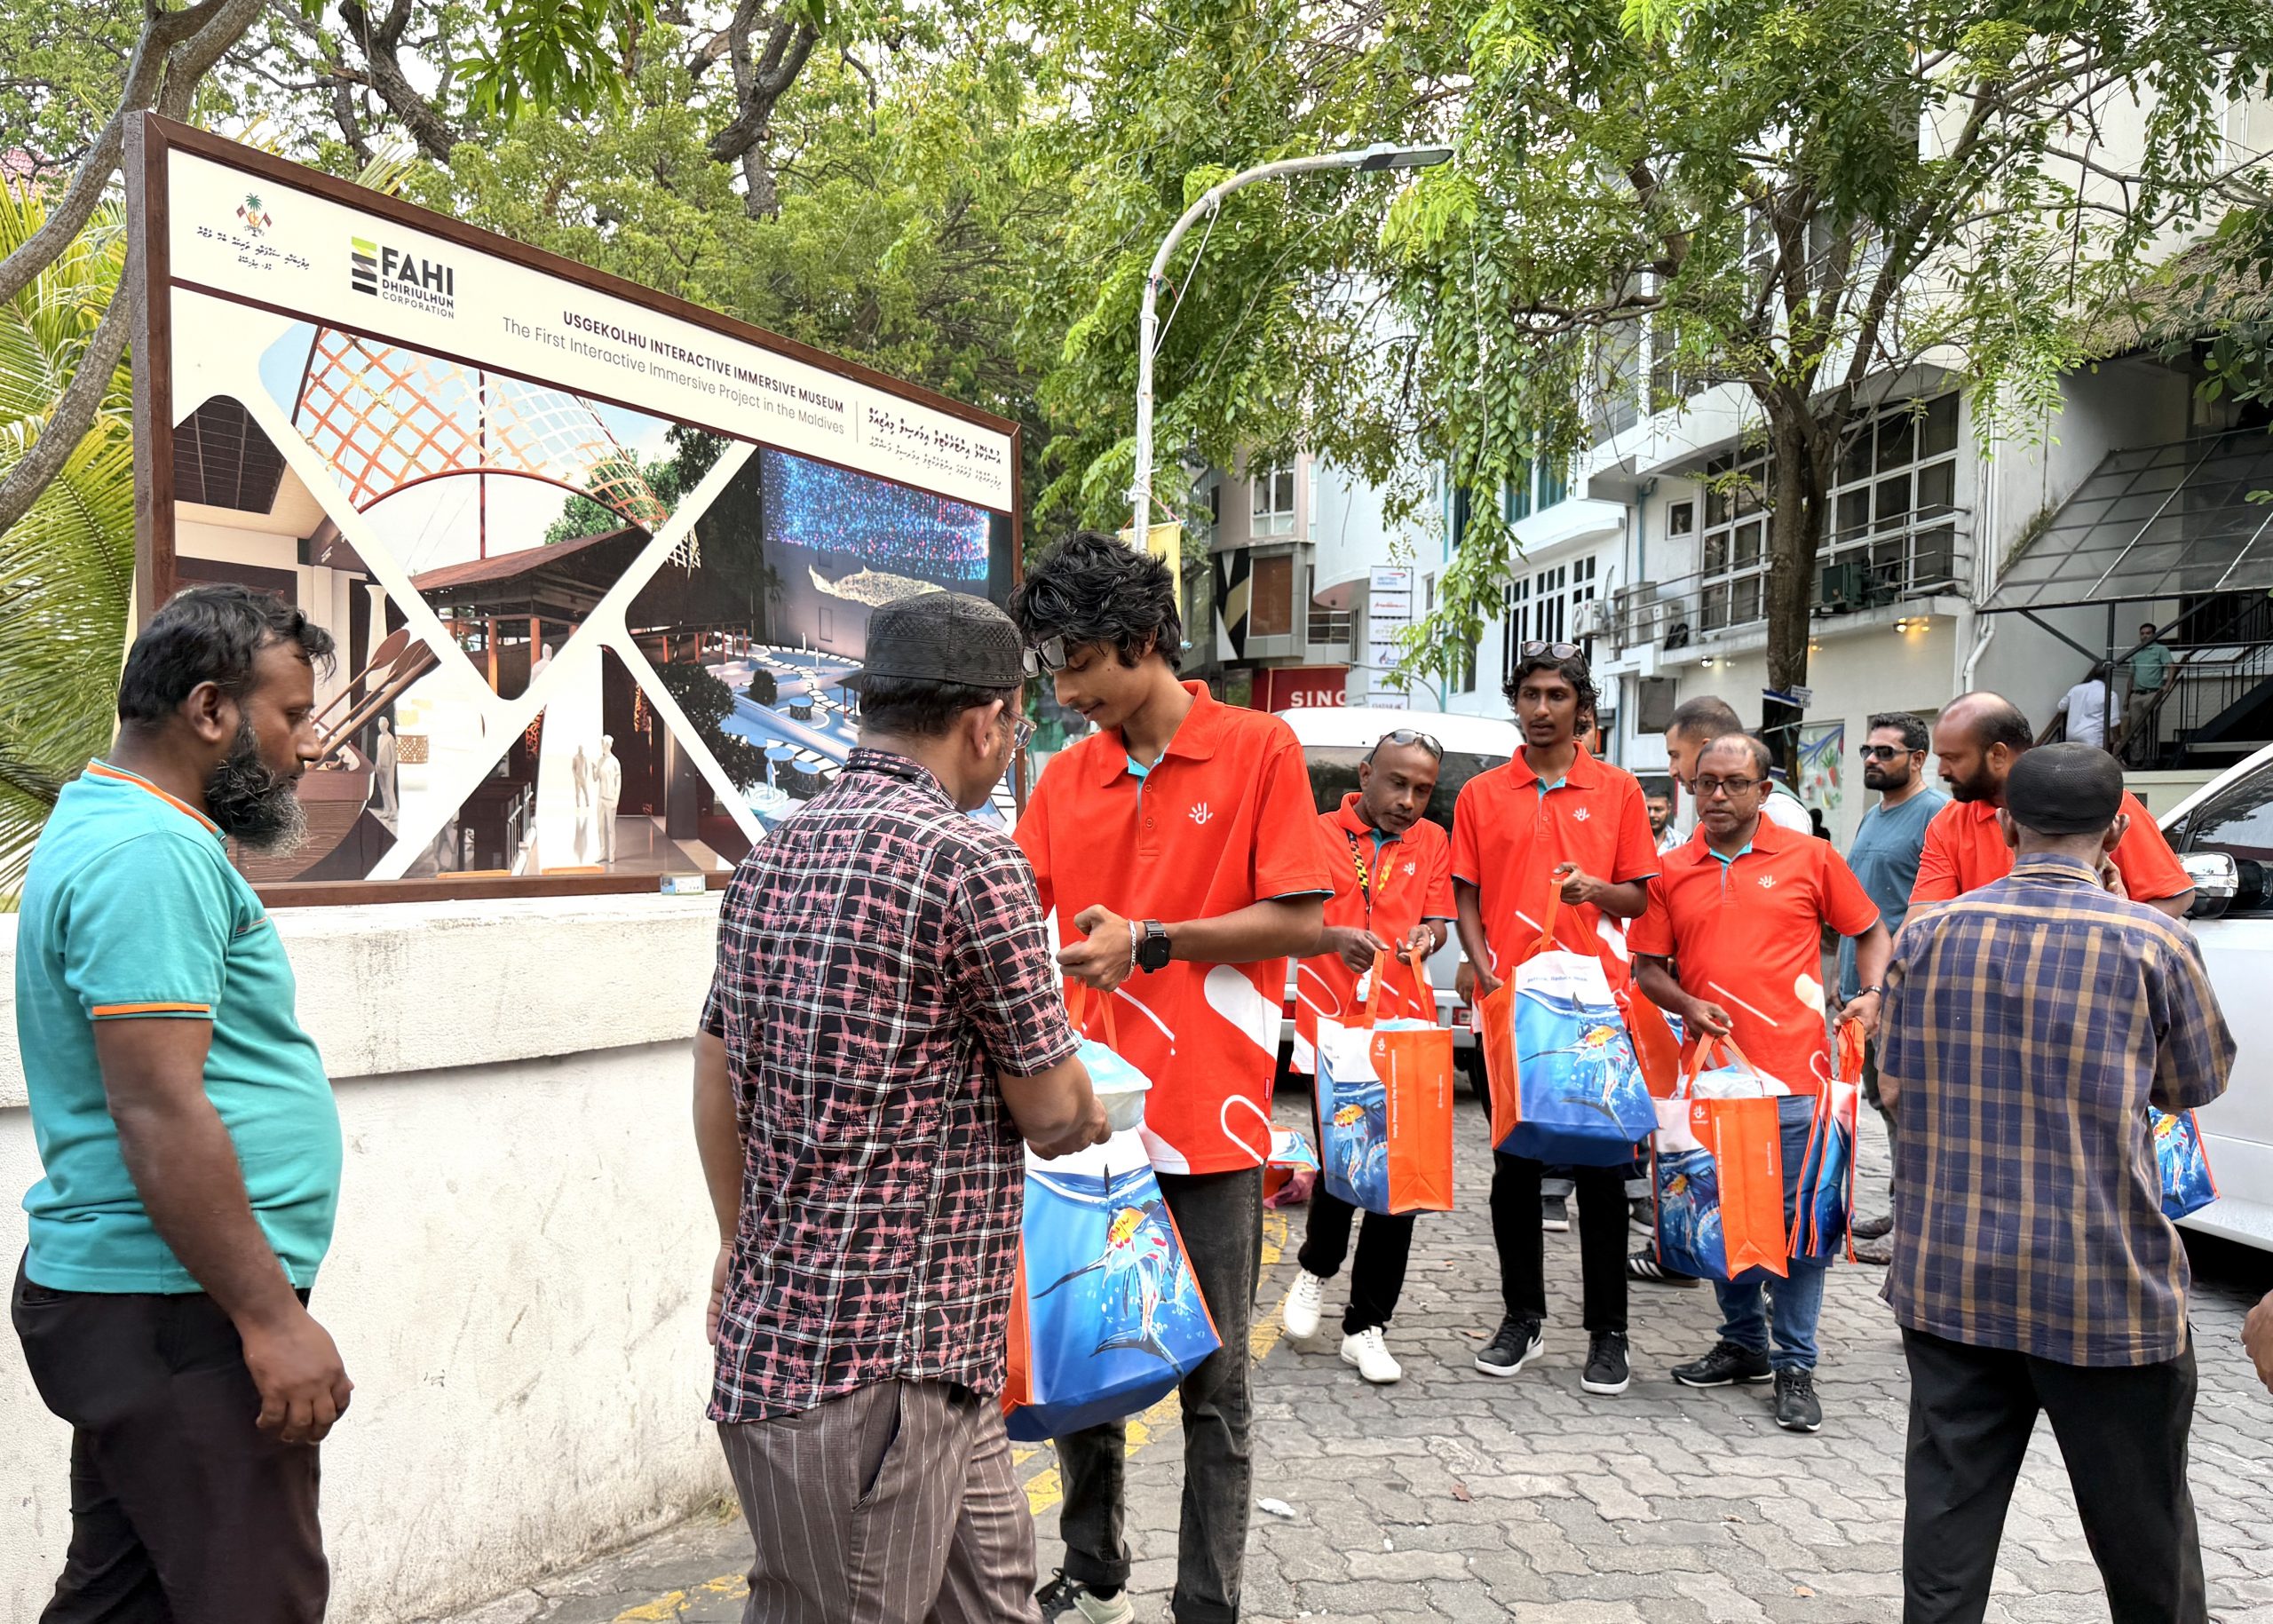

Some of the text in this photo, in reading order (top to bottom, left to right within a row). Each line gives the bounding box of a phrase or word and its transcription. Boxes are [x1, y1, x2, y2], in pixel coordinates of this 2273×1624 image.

[382, 245, 454, 297] FAHI
[382, 278, 454, 310] DHIRIULHUN
[382, 291, 455, 320] CORPORATION
[503, 316, 844, 434] The First Interactive Immersive Project in the Maldives
[563, 311, 844, 414] USGEKOLHU INTERACTIVE IMMERSIVE MUSEUM
